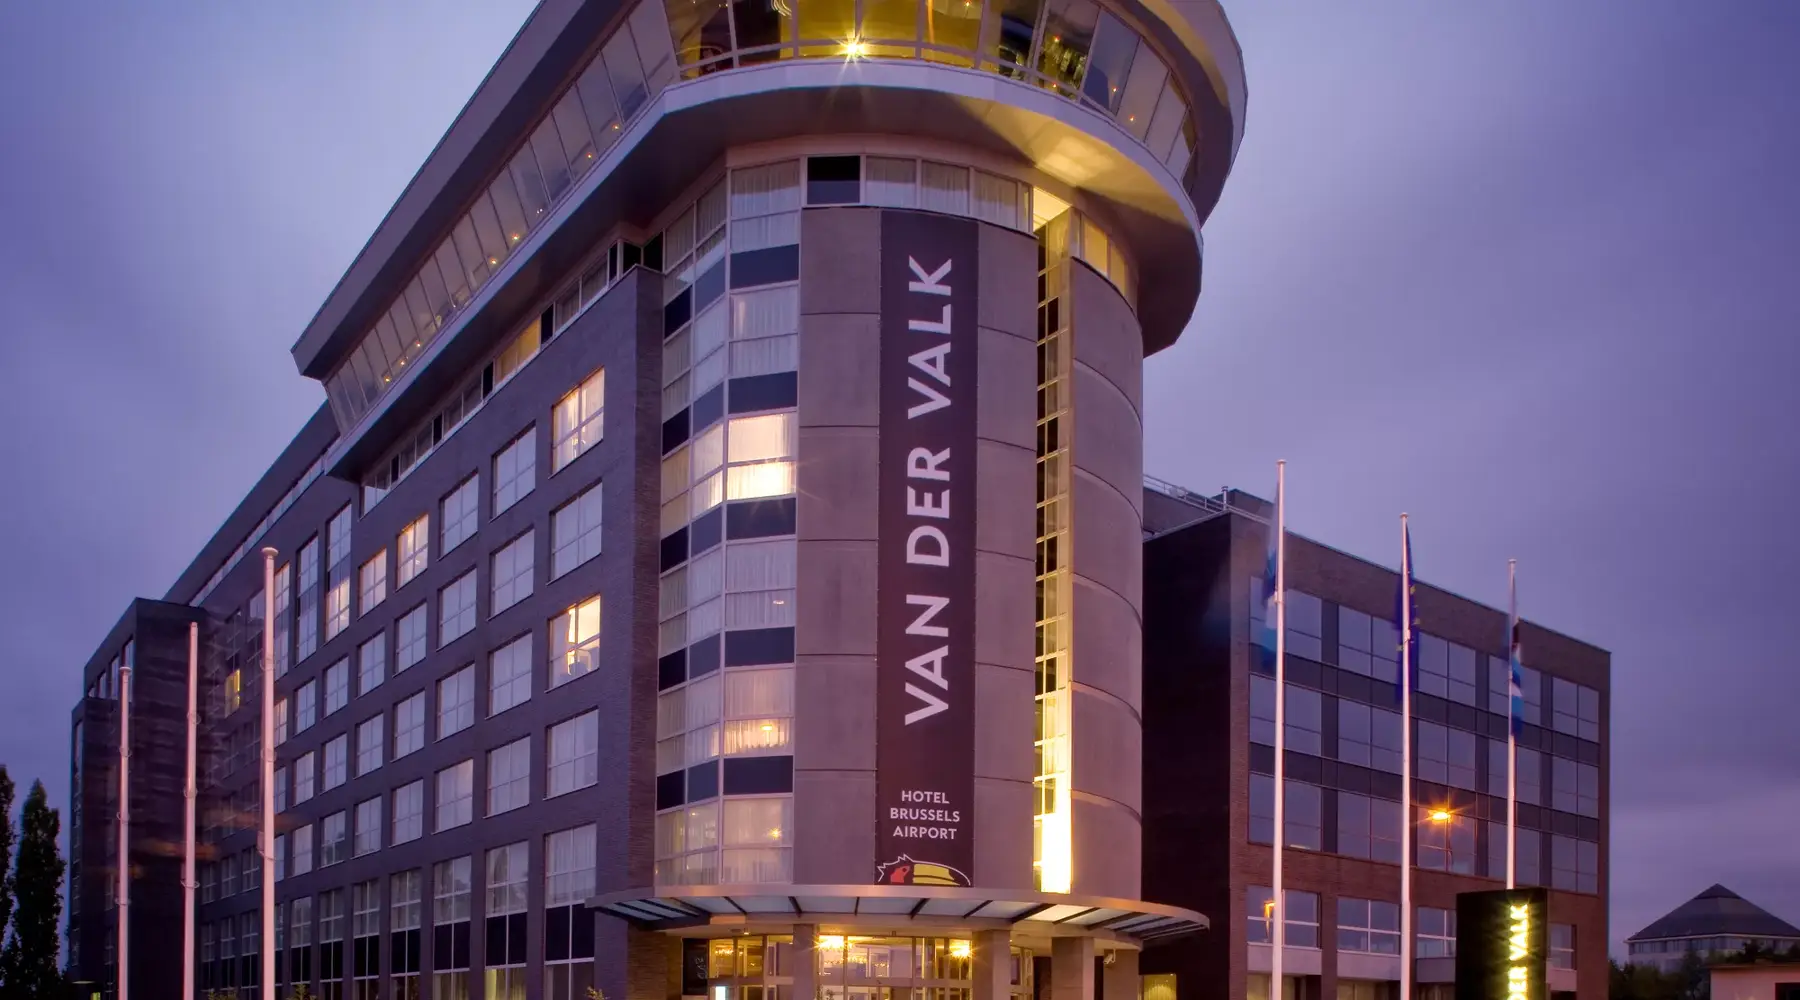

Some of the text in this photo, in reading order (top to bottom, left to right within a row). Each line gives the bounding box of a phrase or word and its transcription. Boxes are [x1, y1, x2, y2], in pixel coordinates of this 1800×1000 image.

[904, 255, 953, 726] VAN DER VALK
[901, 790, 950, 804] HOTEL
[890, 807, 961, 822] BRUSSELS
[893, 825, 957, 839] AIRPORT
[1509, 903, 1528, 961] VALK
